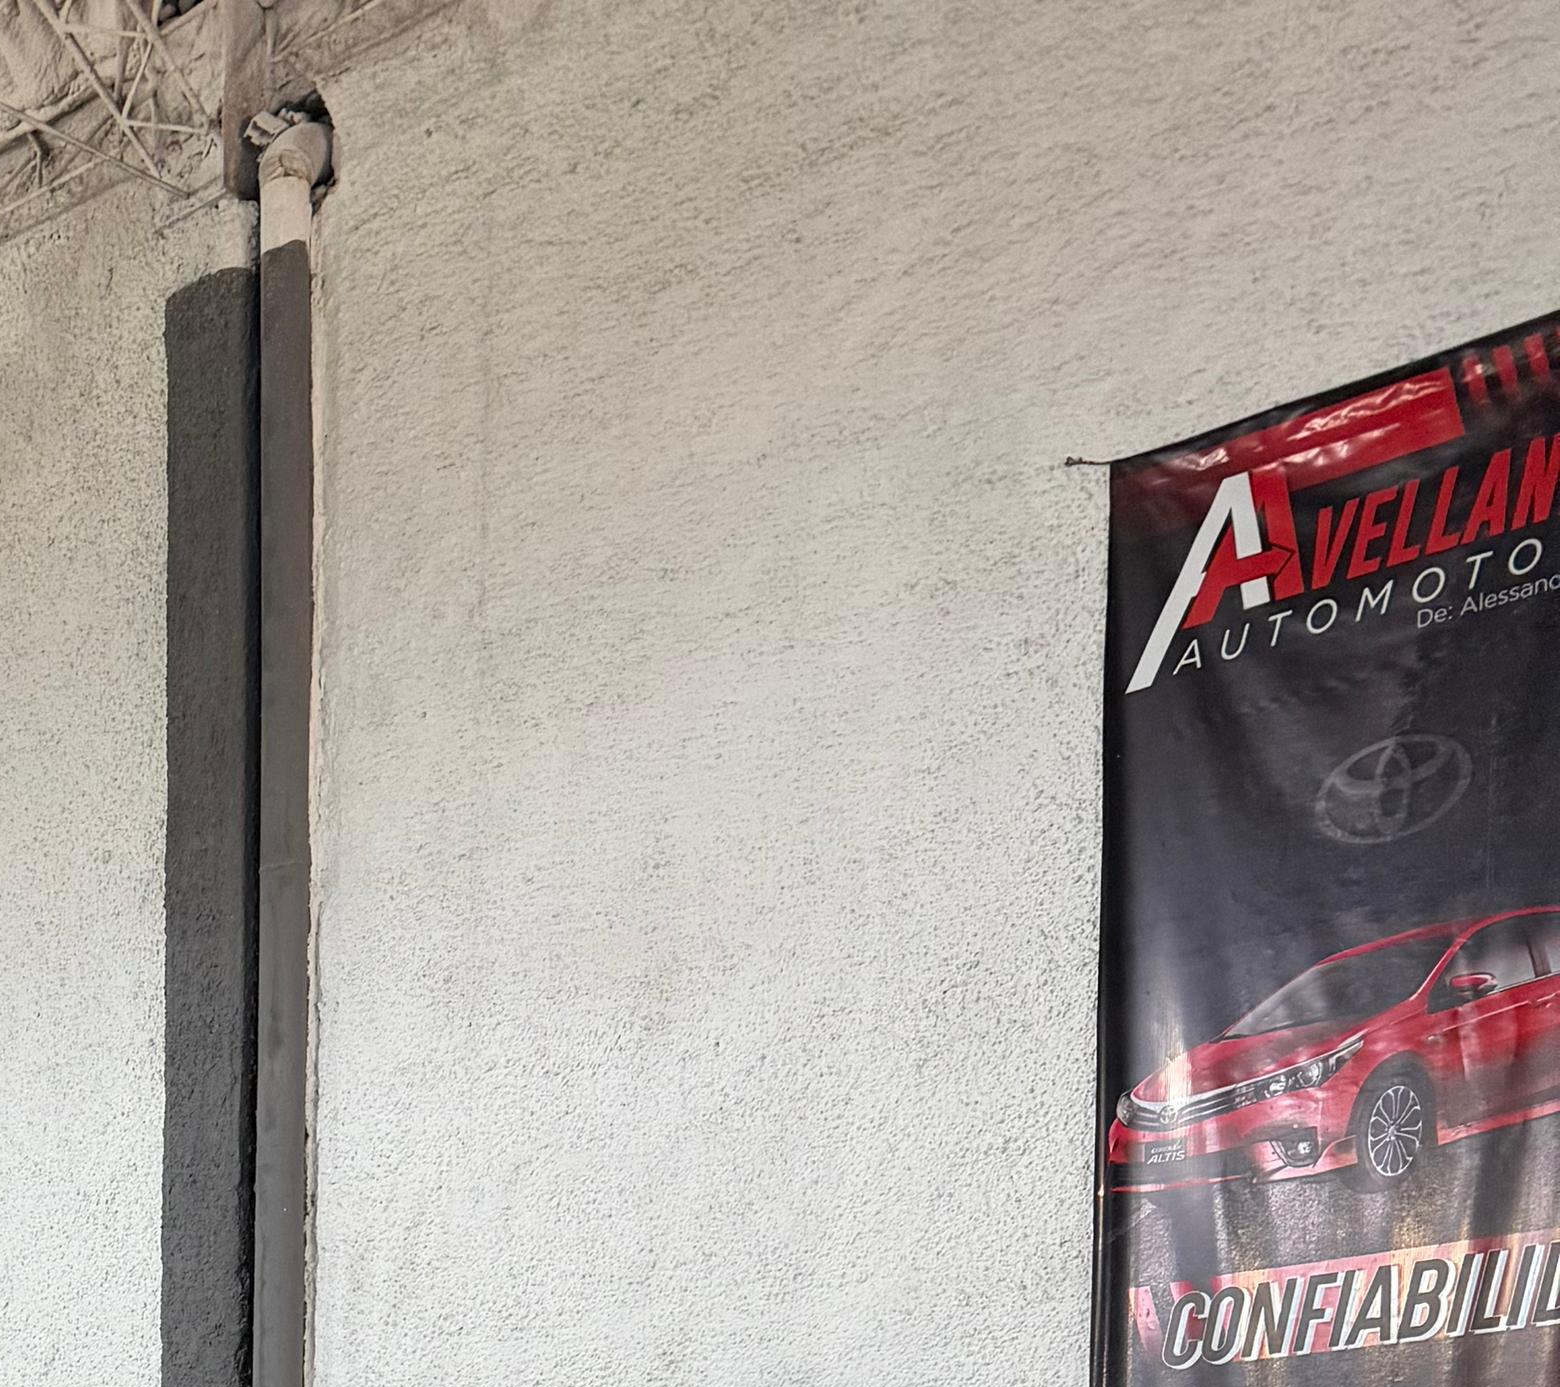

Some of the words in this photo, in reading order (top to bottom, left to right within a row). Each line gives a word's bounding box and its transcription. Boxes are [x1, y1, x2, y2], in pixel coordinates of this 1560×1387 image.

[1173, 538, 1542, 675] AUTOMOTO
[1417, 606, 1453, 629] De:
[1147, 1151, 1185, 1165] ALTIS
